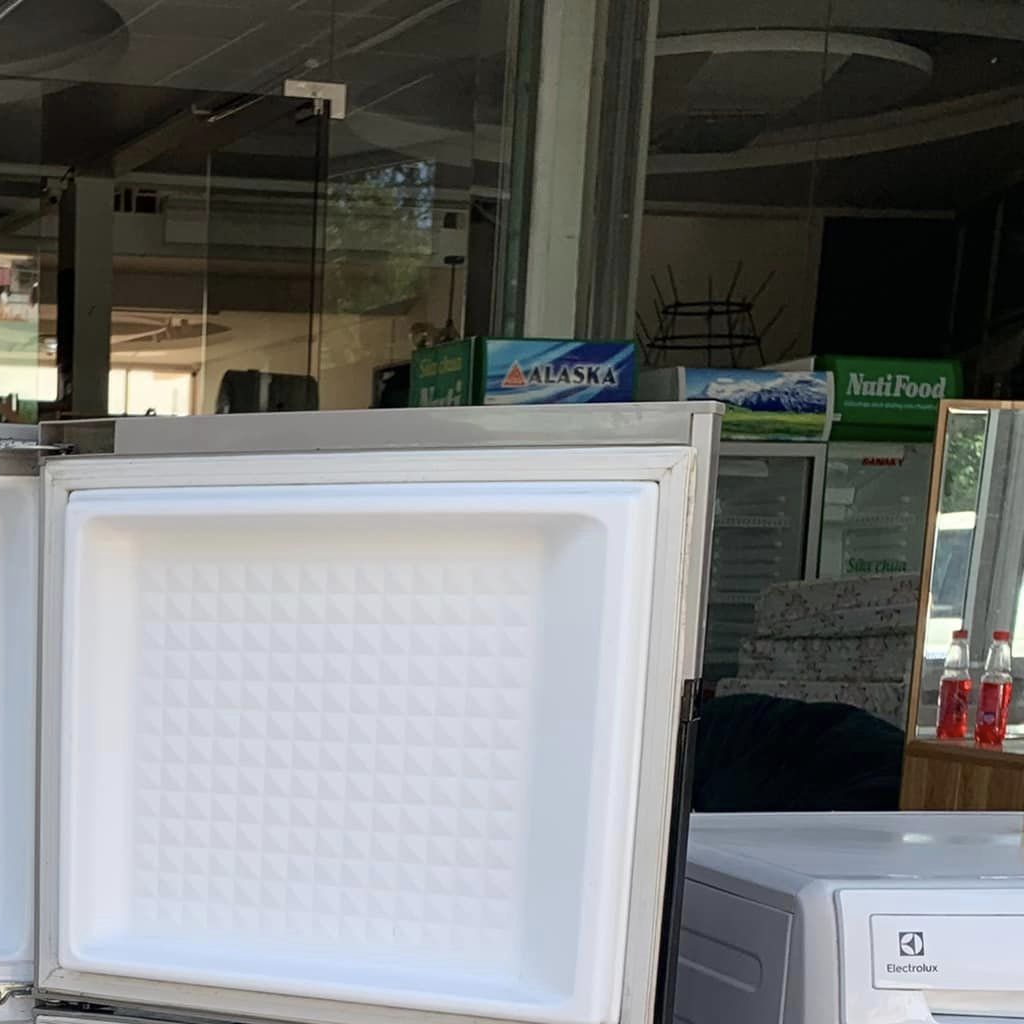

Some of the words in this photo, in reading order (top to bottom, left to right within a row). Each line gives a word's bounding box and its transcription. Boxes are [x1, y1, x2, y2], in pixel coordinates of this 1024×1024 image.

[528, 364, 616, 385] ALASKA
[846, 372, 947, 399] NutiFood
[886, 963, 938, 974] Electrolux
